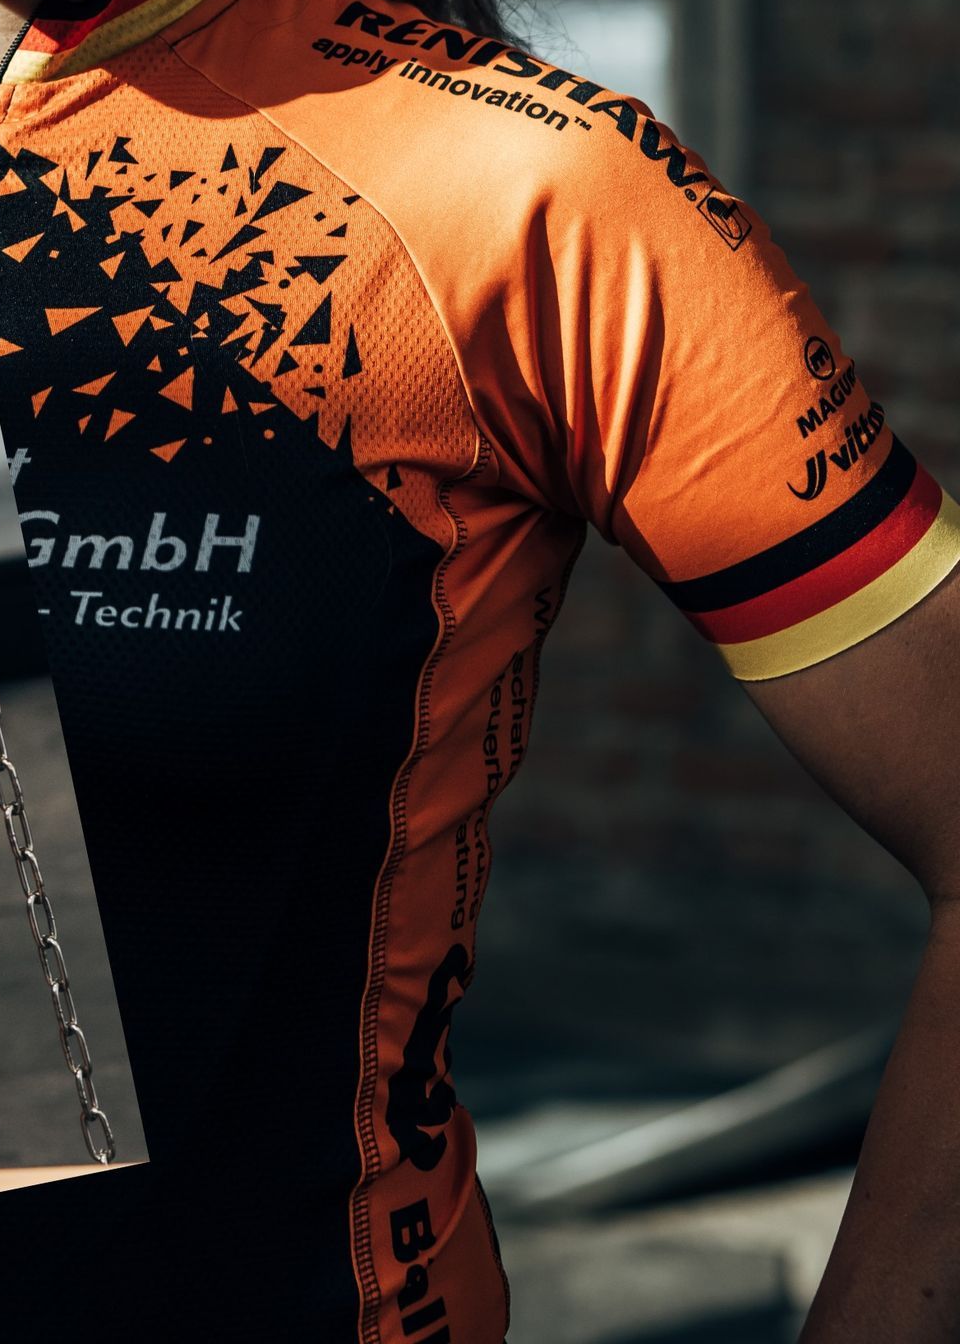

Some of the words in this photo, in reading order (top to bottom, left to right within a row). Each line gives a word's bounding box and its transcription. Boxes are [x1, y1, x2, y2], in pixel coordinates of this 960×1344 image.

[311, 35, 398, 75] apply
[18, 510, 260, 573] GmbH
[70, 590, 243, 632] Technik
